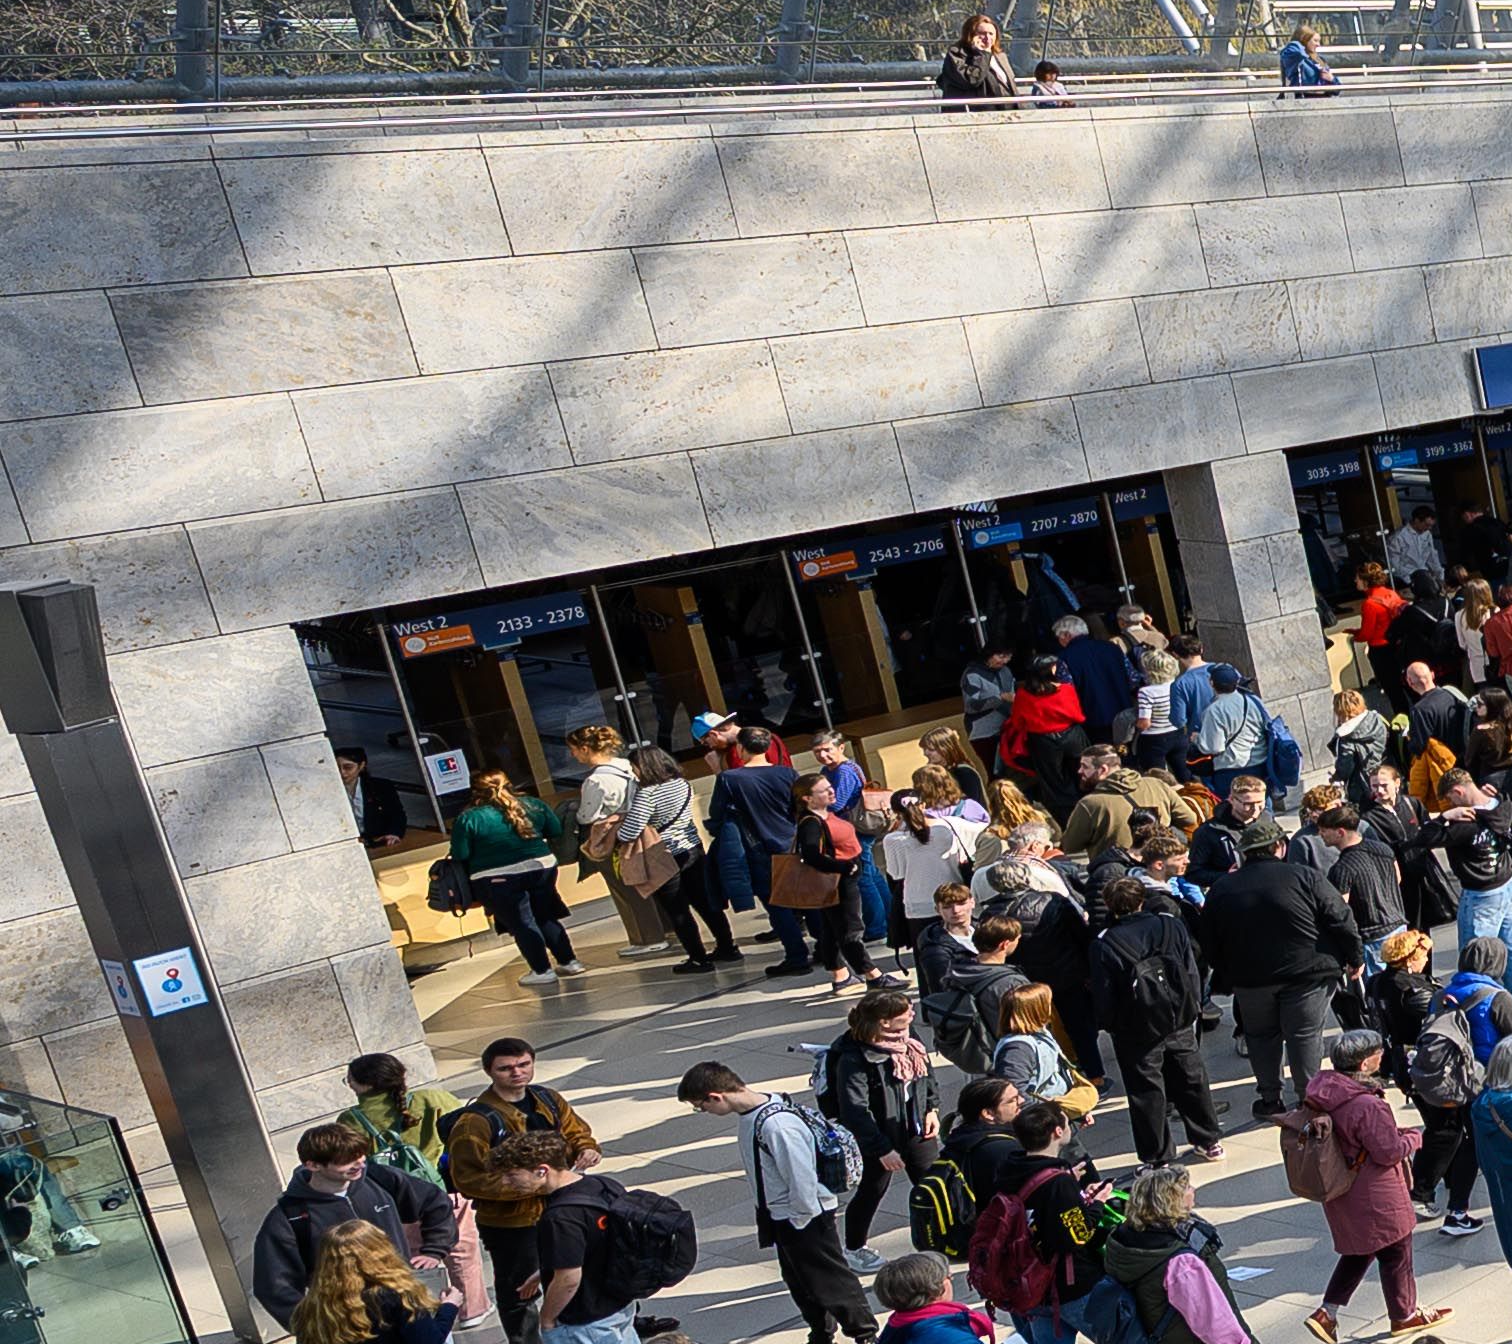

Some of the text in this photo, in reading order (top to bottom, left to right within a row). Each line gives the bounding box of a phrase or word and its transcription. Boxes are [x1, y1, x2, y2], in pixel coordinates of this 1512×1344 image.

[1485, 423, 1512, 435] West 2
[1372, 442, 1401, 456] West 2
[1453, 440, 1474, 453] 3362
[1306, 468, 1330, 481] 3035
[1338, 461, 1360, 475] 3198
[1140, 488, 1147, 499] 2
[963, 514, 1001, 531] West 2
[1031, 517, 1059, 532] 2707
[1070, 510, 1098, 525] 2870
[793, 547, 825, 562] West
[869, 546, 901, 563] 2543
[913, 538, 944, 555] 2706
[393, 615, 449, 637] West 2
[496, 616, 533, 634] 2133
[546, 606, 585, 625] 2378
